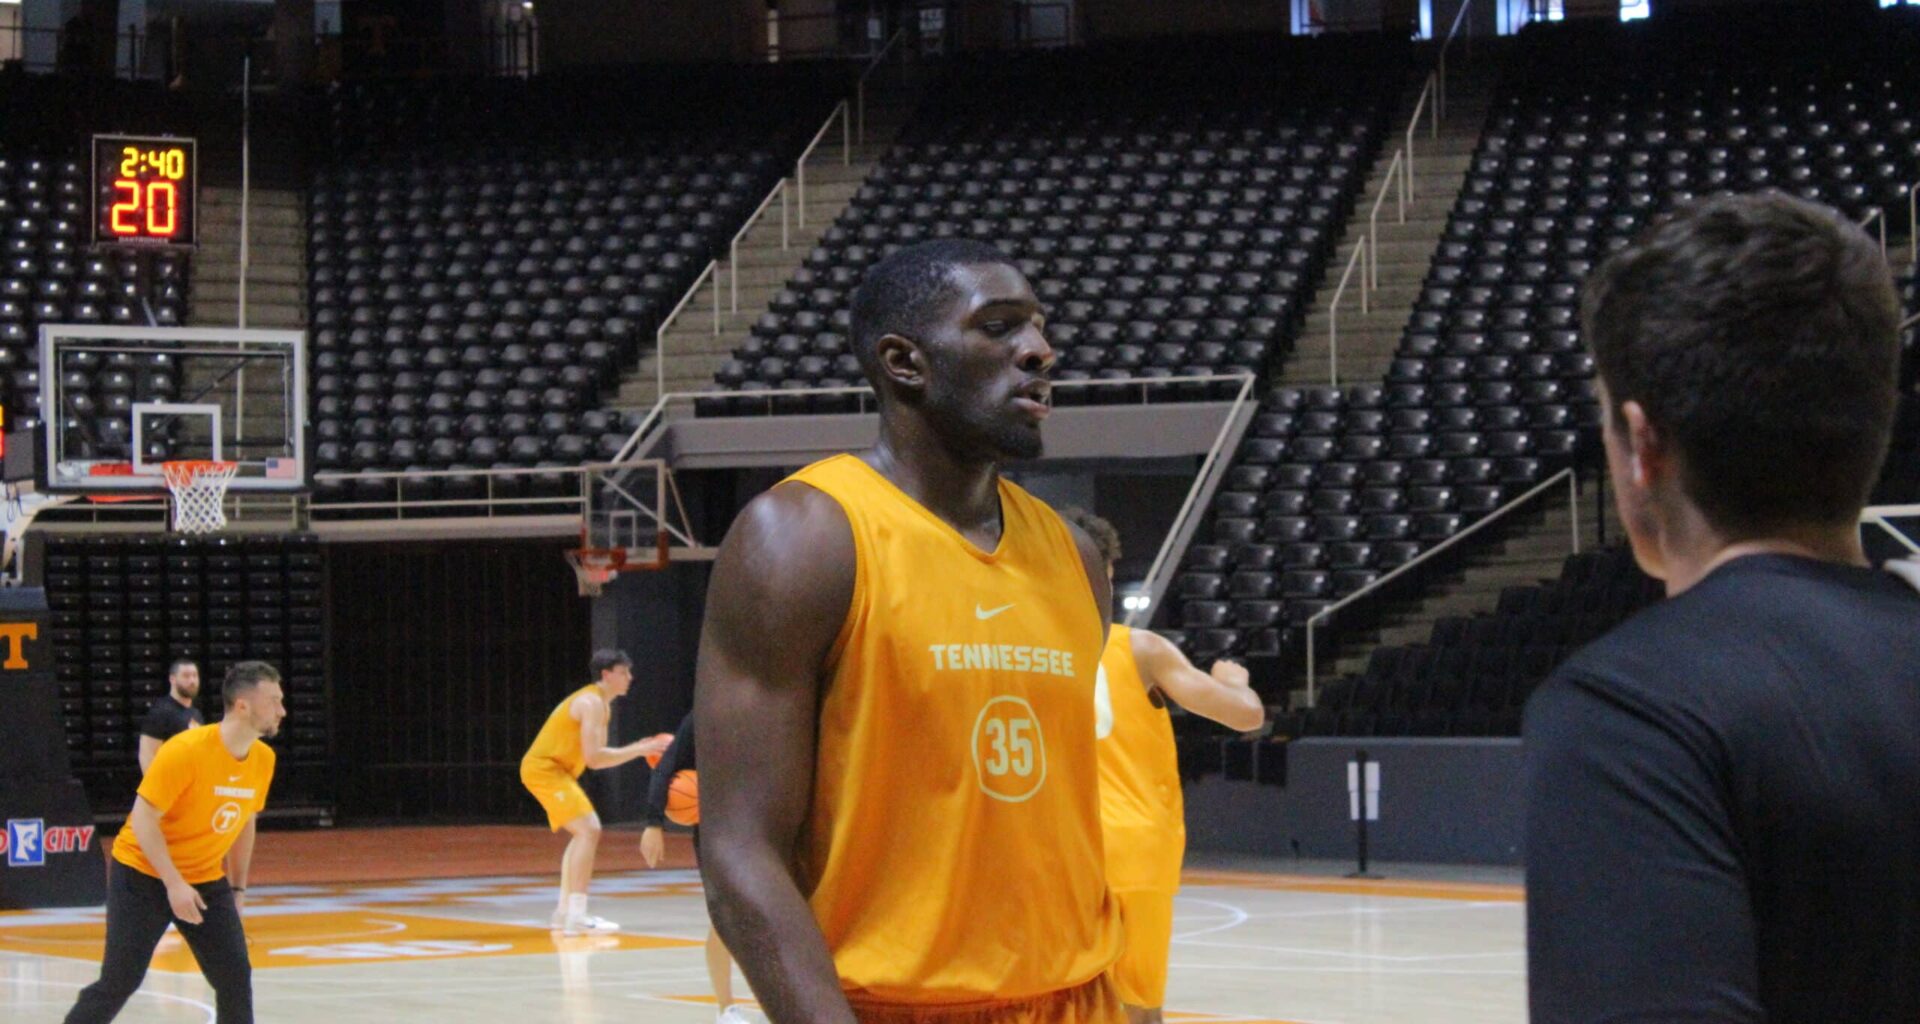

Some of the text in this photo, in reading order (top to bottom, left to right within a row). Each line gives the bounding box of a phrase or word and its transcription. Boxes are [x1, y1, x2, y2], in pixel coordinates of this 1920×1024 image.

[121, 147, 184, 179] 2:40
[112, 181, 175, 233] 20
[0, 622, 38, 669] T
[929, 643, 1075, 677] TENNESSEE
[985, 717, 1034, 777] 35
[44, 825, 95, 853] CITY
